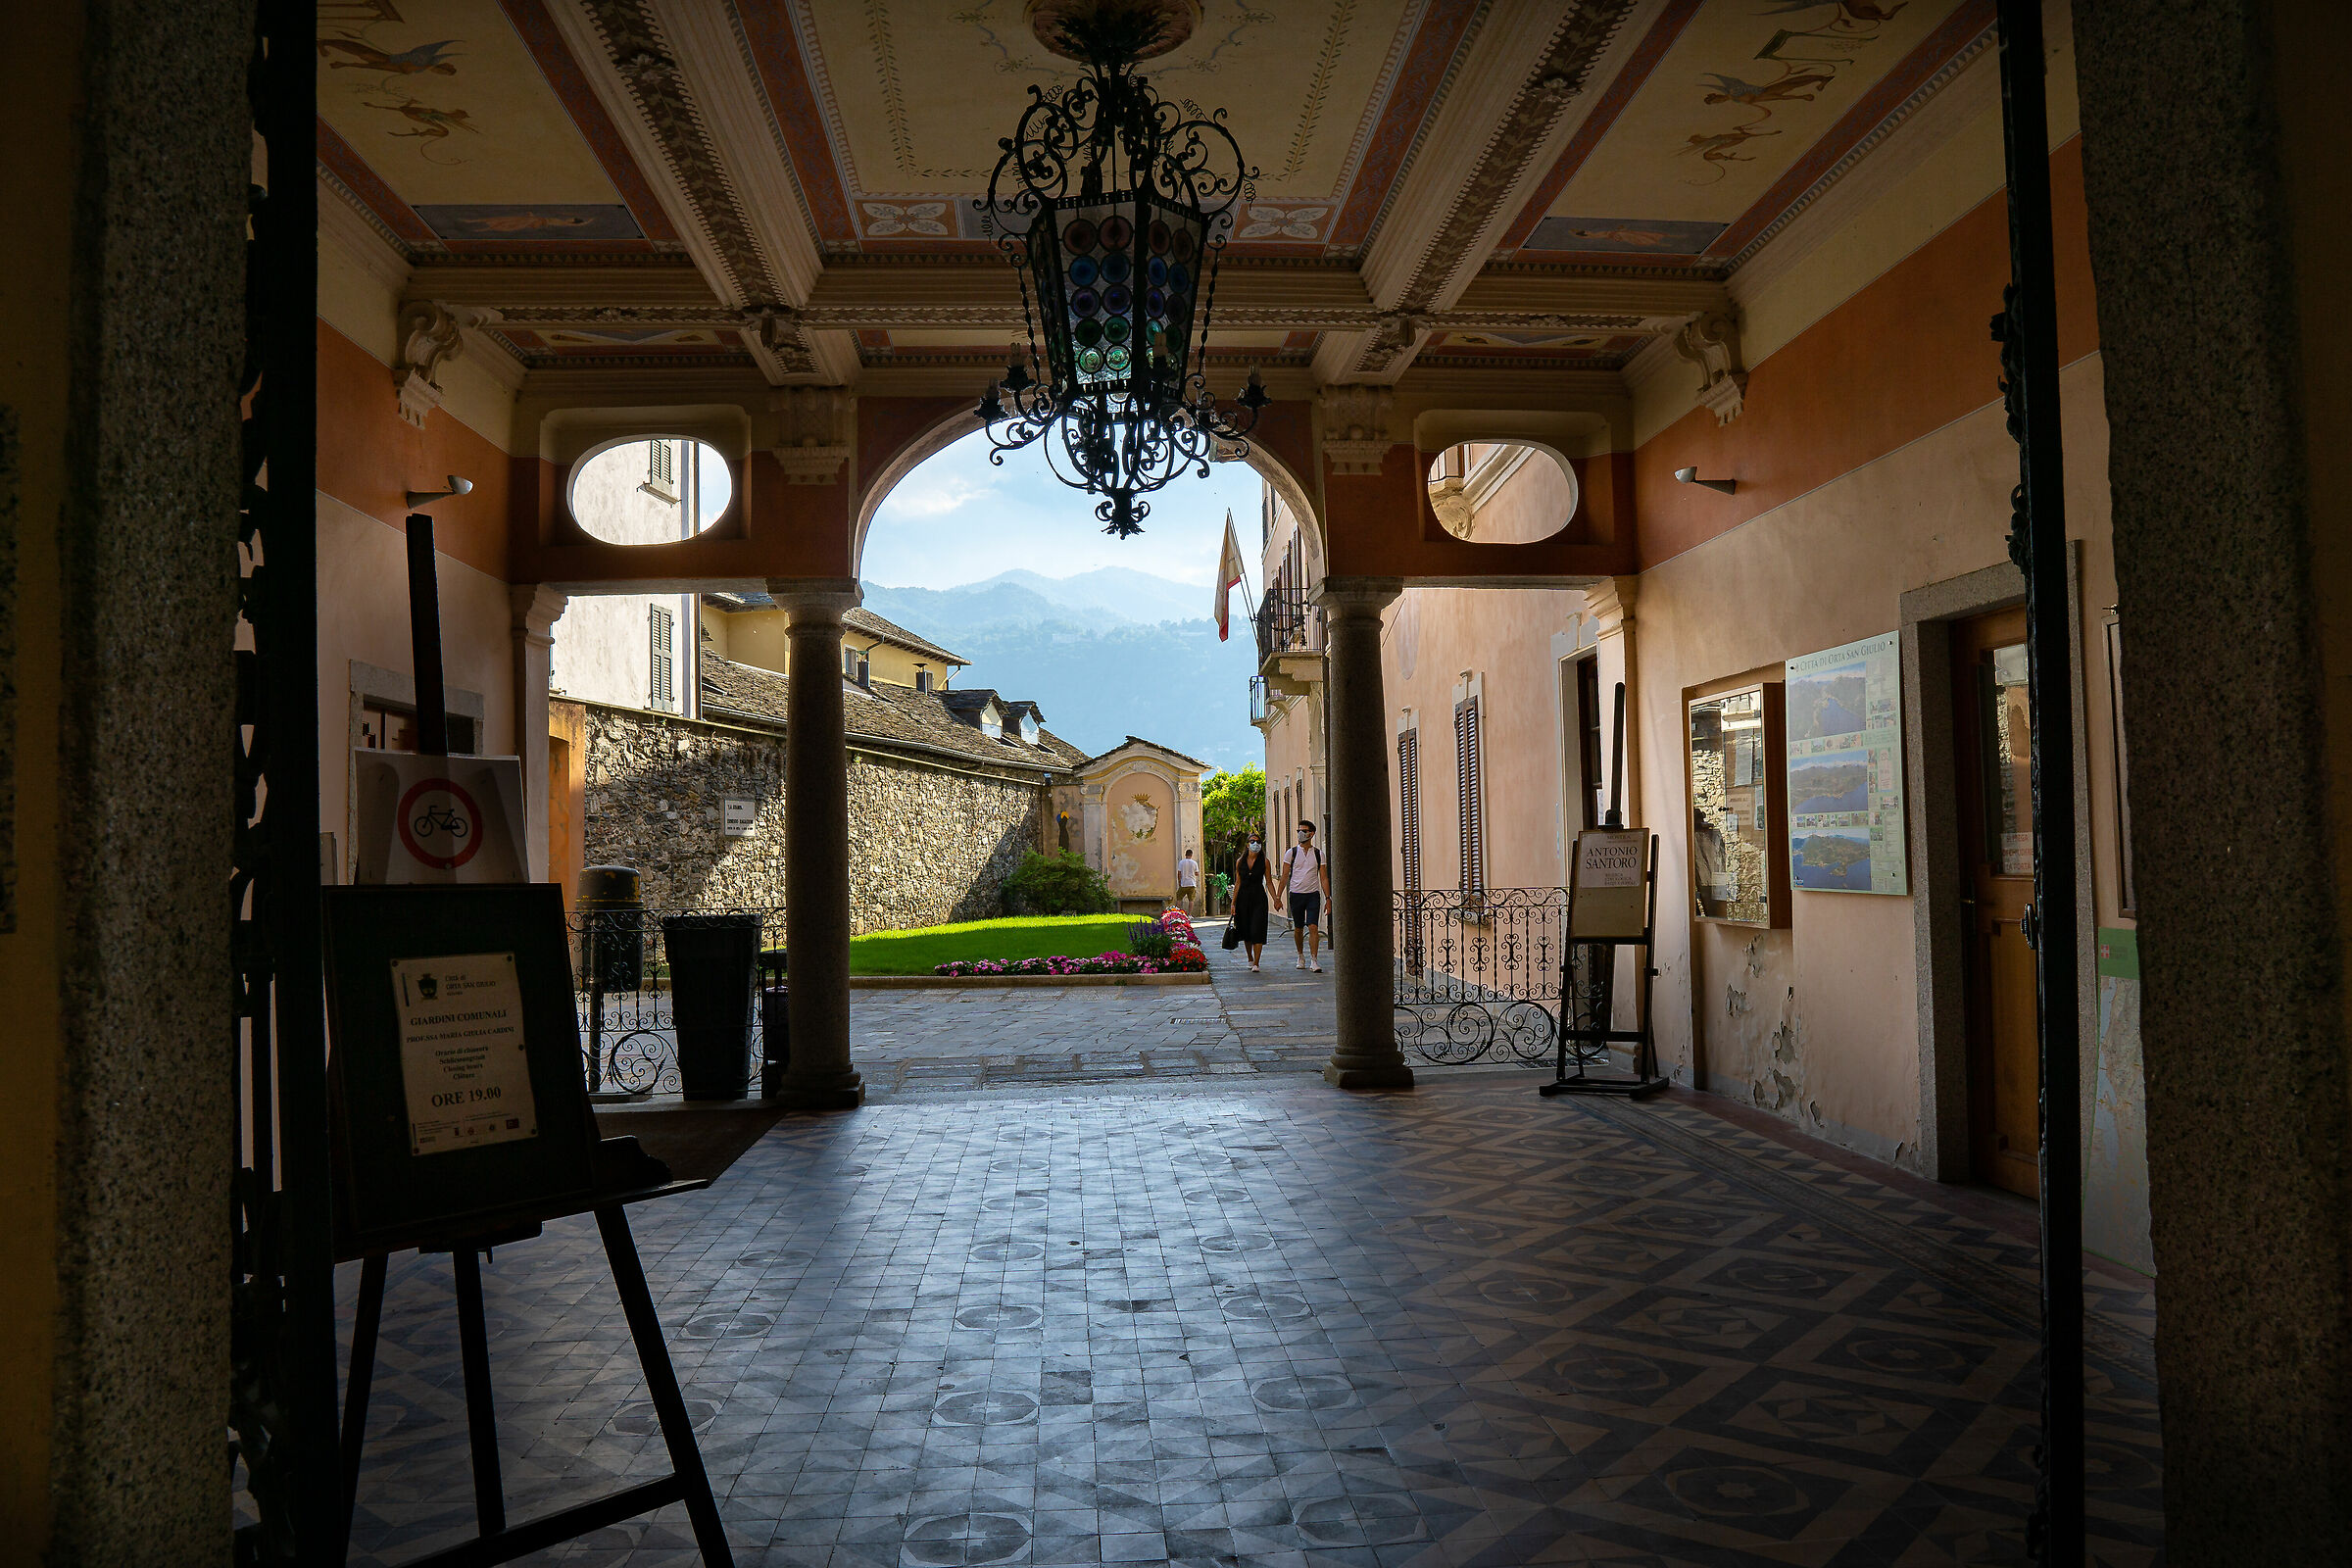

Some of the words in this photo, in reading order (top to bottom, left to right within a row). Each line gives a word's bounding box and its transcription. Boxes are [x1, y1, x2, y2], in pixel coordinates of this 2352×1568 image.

[1820, 657, 1827, 667] DI
[1828, 653, 1845, 664] ORTA
[1846, 650, 1859, 661] SAN
[1860, 641, 1886, 656] GIULIO
[1588, 846, 1638, 857] ANTONIO
[1586, 857, 1637, 869] SANTORO
[410, 1013, 456, 1026] GIARDINI
[457, 1009, 507, 1022] COMUNALI
[463, 1029, 487, 1038] GIULIA
[487, 1026, 514, 1035] CARDINI
[431, 1091, 465, 1107] ORE
[468, 1086, 502, 1102] 19.00
